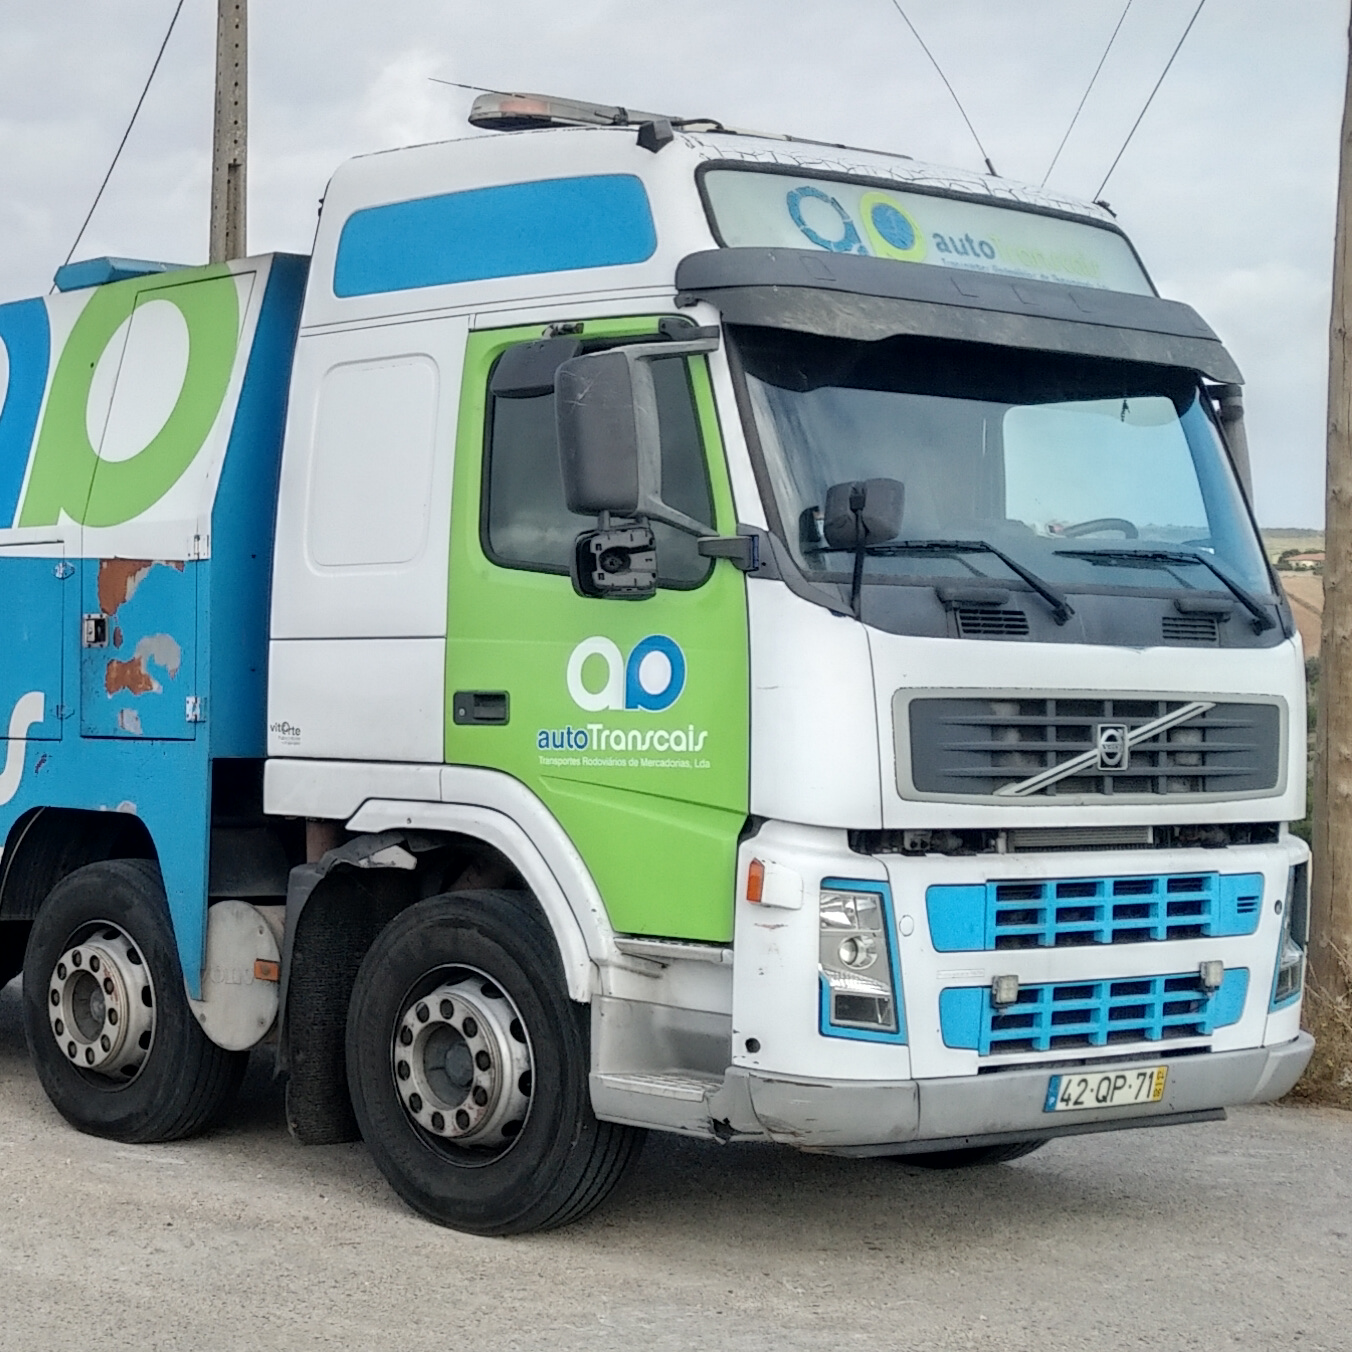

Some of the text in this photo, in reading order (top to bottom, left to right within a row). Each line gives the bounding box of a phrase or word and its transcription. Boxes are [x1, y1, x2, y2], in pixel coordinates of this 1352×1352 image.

[537, 723, 709, 752] autoTranscais
[539, 756, 711, 769] Transportes Rodoviários de Mercadorias, Lda
